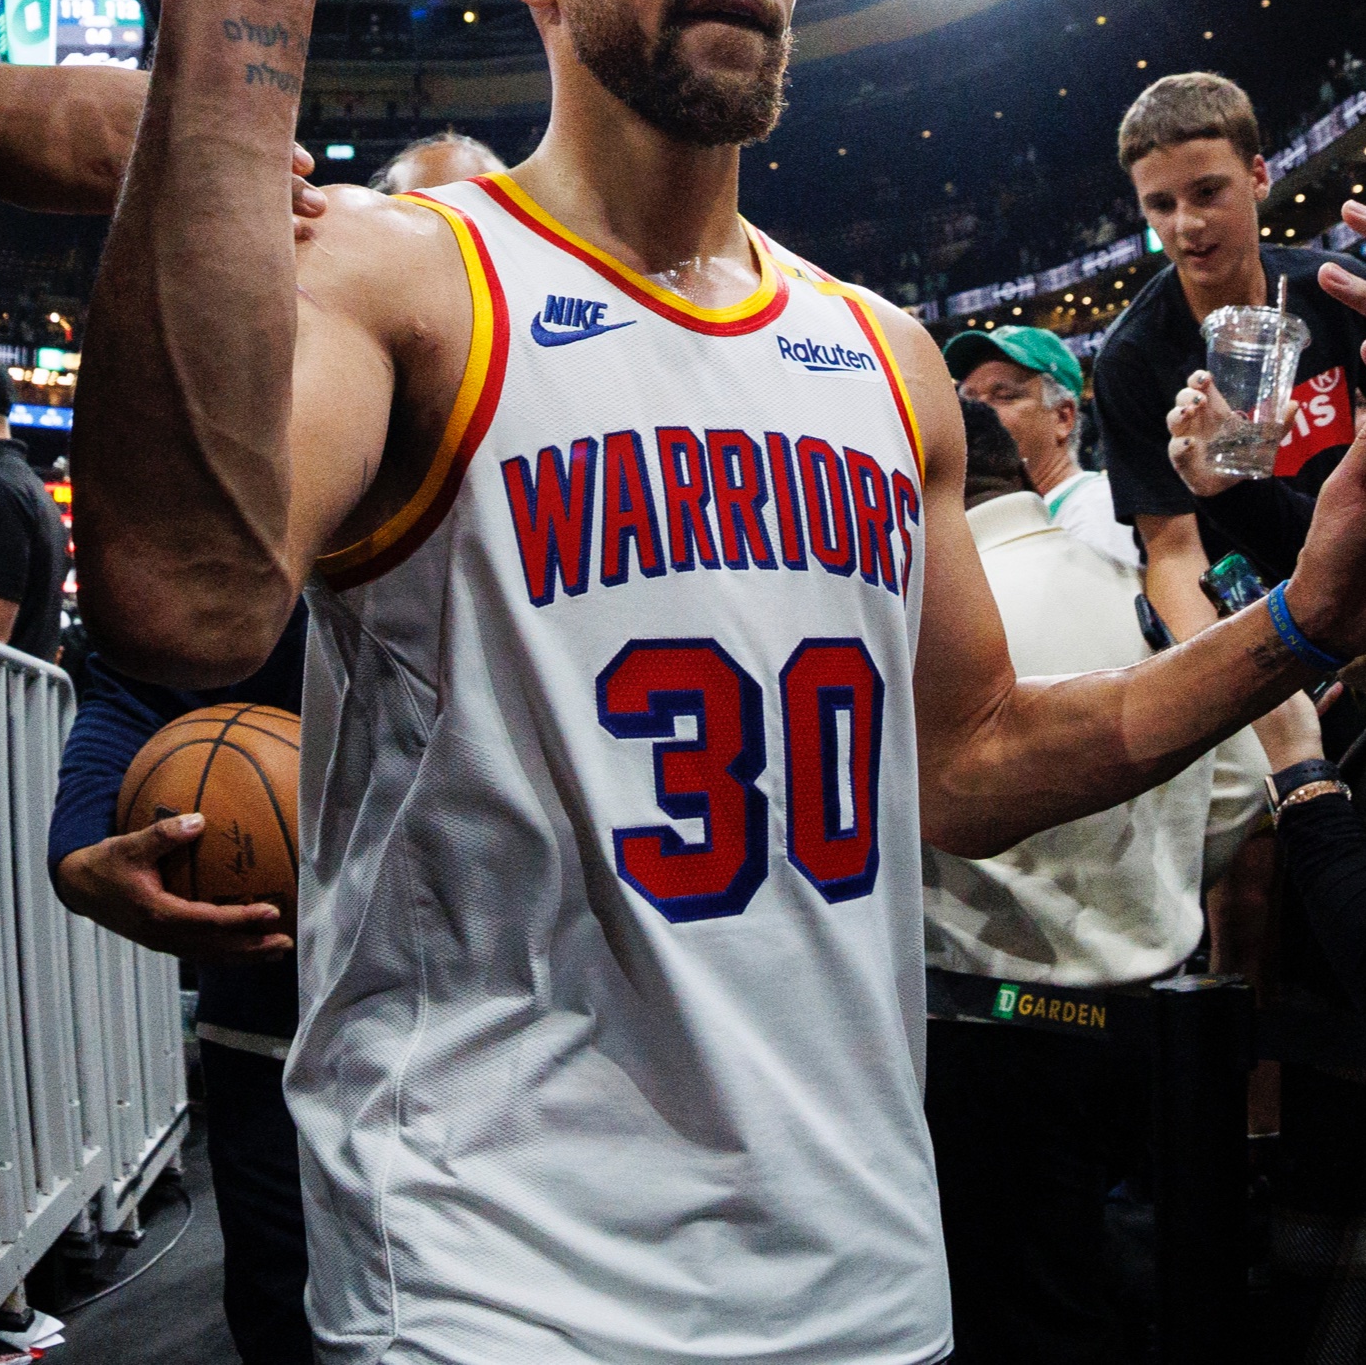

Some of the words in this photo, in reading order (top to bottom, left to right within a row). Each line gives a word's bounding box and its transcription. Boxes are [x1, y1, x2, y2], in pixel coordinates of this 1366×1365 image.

[542, 294, 608, 328] NIKE
[776, 334, 876, 372] Rakuten
[501, 425, 920, 611] WARRIORS
[595, 637, 886, 924] 30
[1017, 992, 1107, 1030] GARDEN
